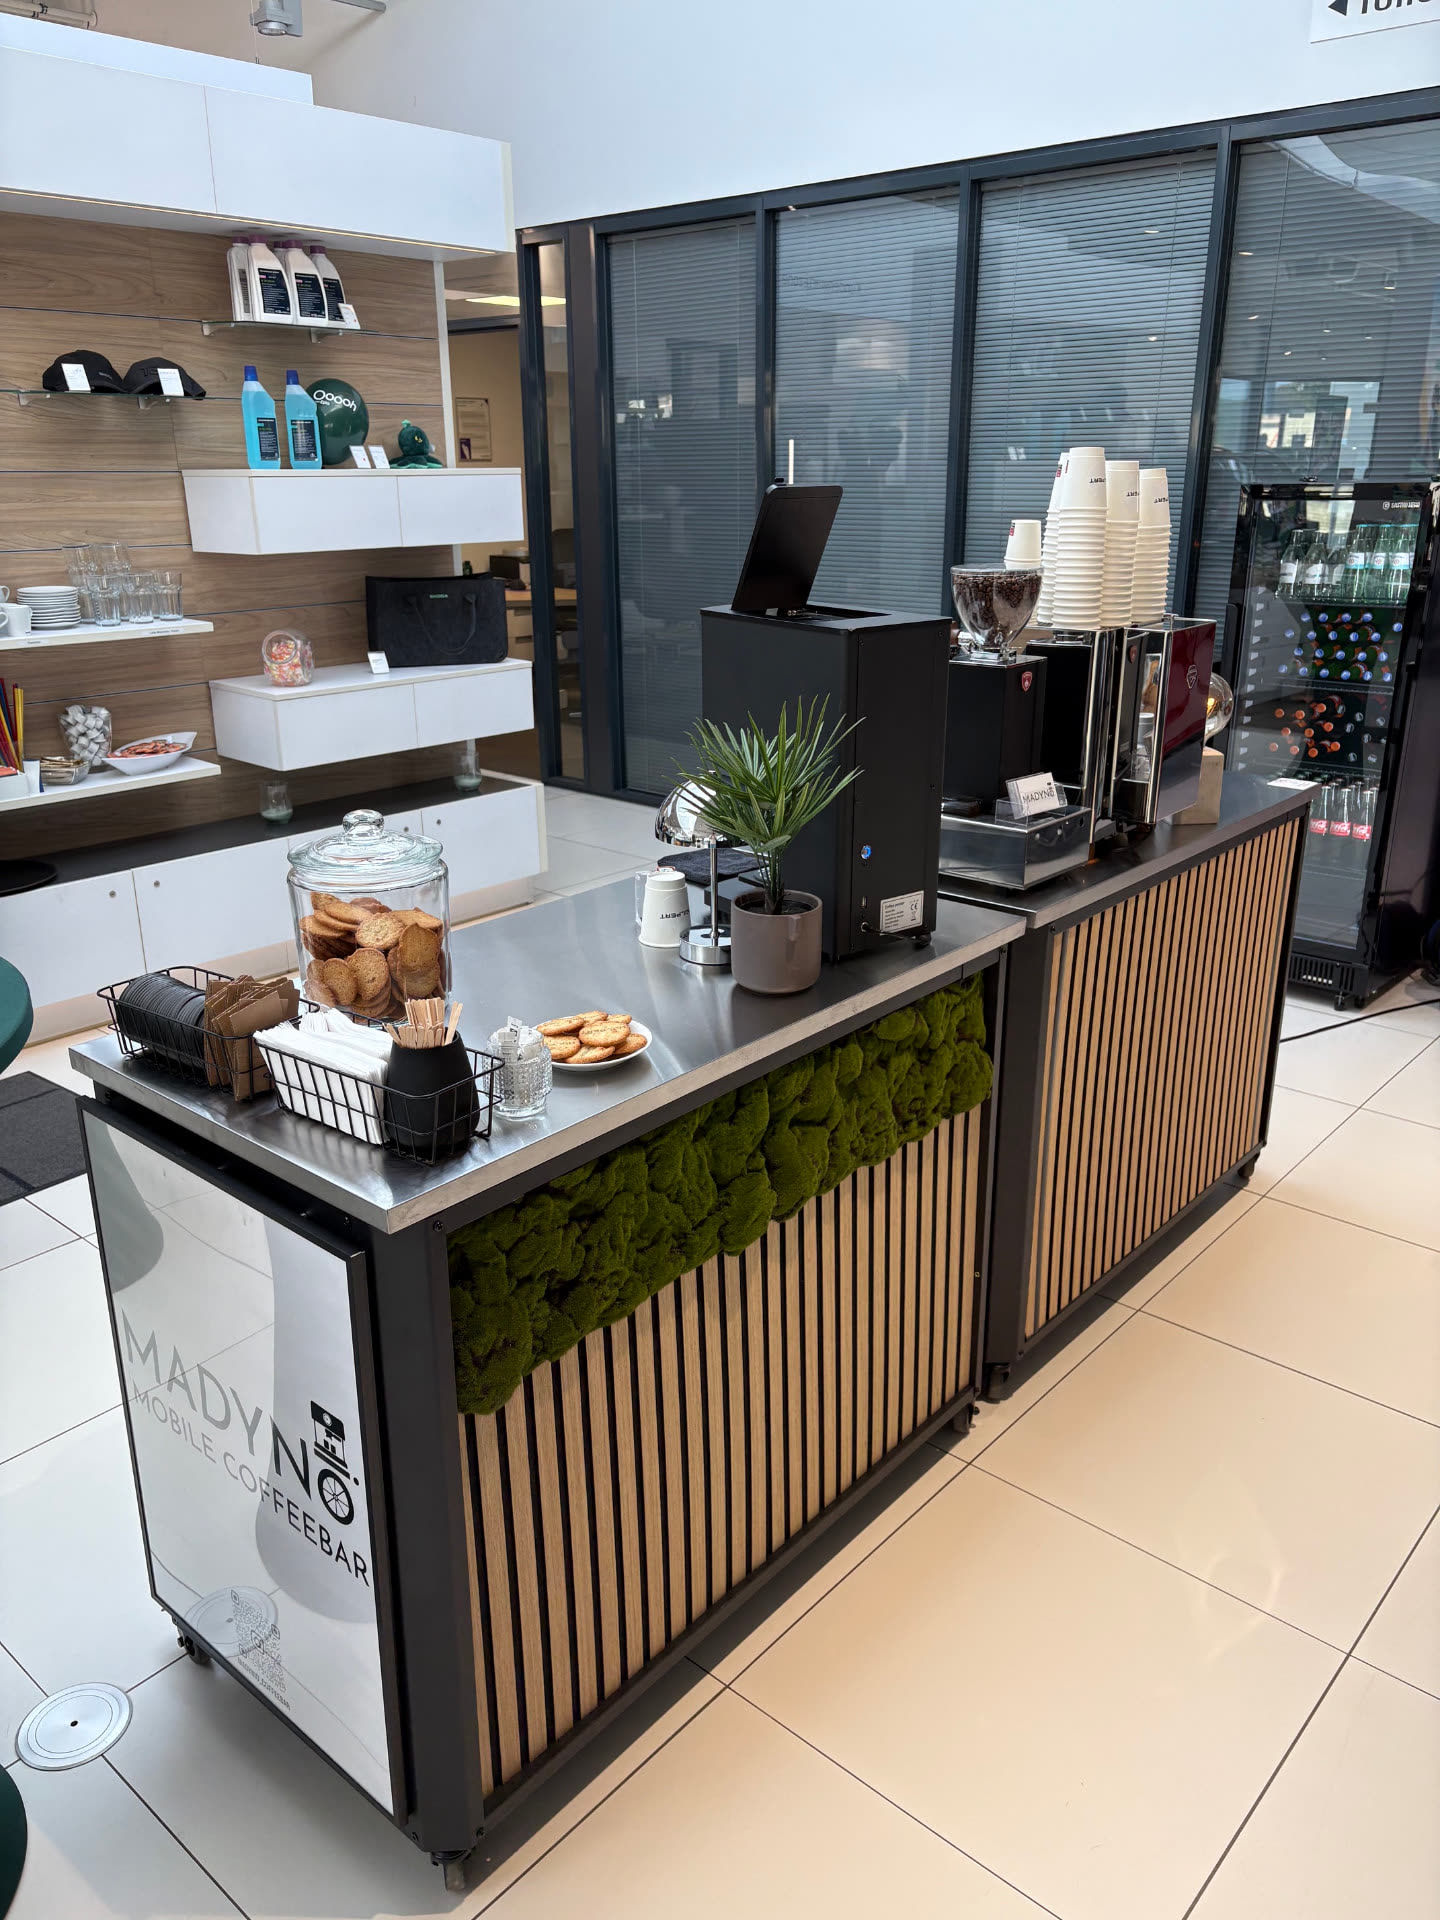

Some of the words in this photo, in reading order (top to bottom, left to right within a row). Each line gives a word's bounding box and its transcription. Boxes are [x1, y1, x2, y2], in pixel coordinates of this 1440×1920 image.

[313, 389, 357, 412] Ooooh
[133, 1380, 217, 1465] MOBILE
[223, 1451, 370, 1587] COFFEEBAR
